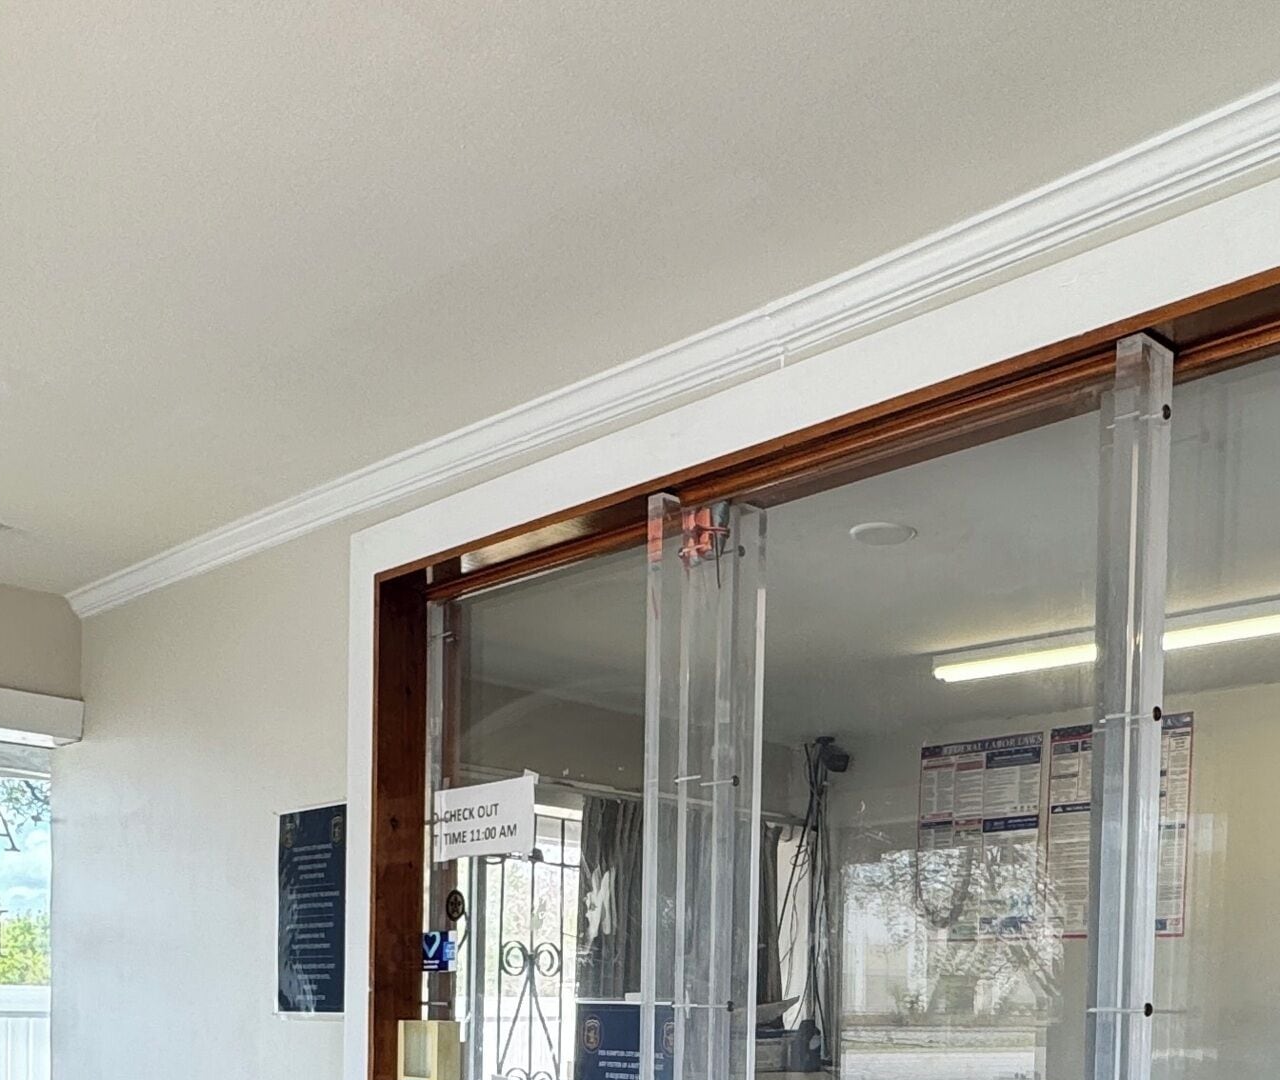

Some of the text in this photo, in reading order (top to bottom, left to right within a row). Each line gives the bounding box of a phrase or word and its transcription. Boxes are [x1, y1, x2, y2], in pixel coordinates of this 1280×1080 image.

[942, 742, 982, 754] FEDERAL
[985, 738, 1016, 751] LABOR
[443, 806, 475, 823] CHECK
[477, 803, 499, 819] OUT
[443, 830, 467, 846] TIME
[470, 826, 497, 843] 11:00
[499, 823, 517, 839] AM
